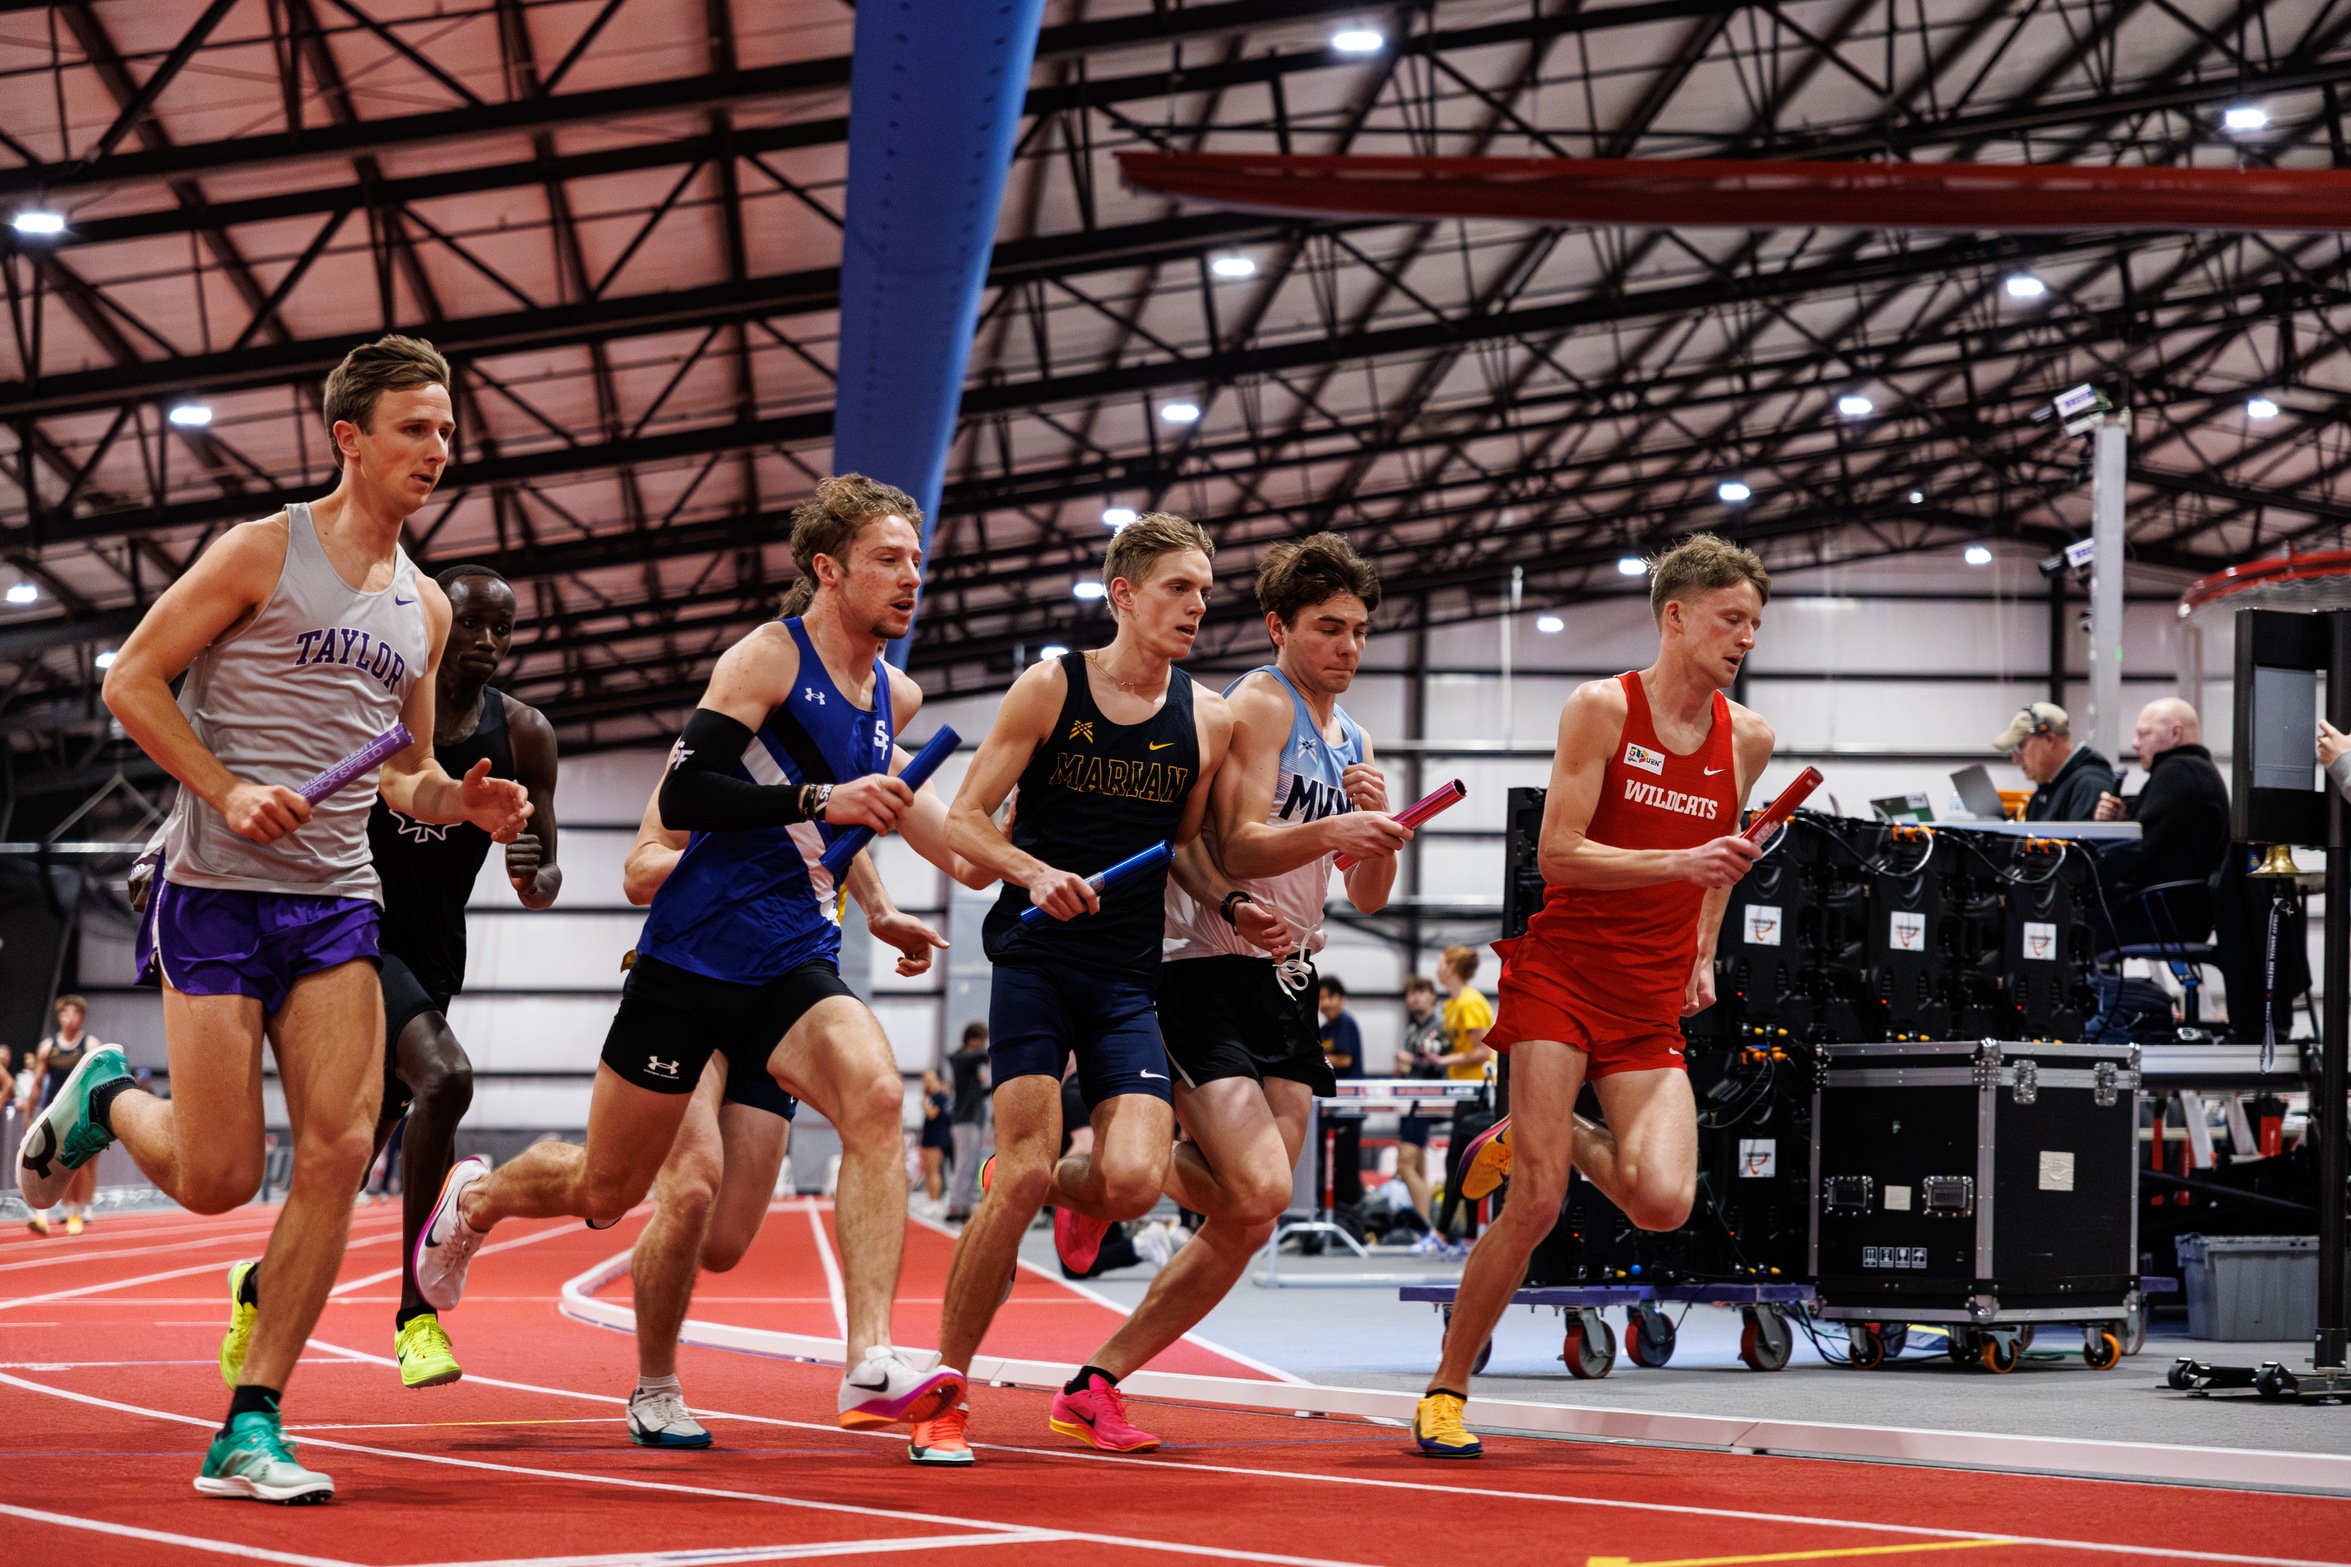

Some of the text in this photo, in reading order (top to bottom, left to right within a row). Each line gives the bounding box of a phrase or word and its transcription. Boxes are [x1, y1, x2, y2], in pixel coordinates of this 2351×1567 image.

[294, 626, 406, 696] TAYLOR
[302, 772, 340, 800] RACK
[1049, 752, 1188, 802] MARIAN
[1624, 779, 1718, 820] WILDCATS
